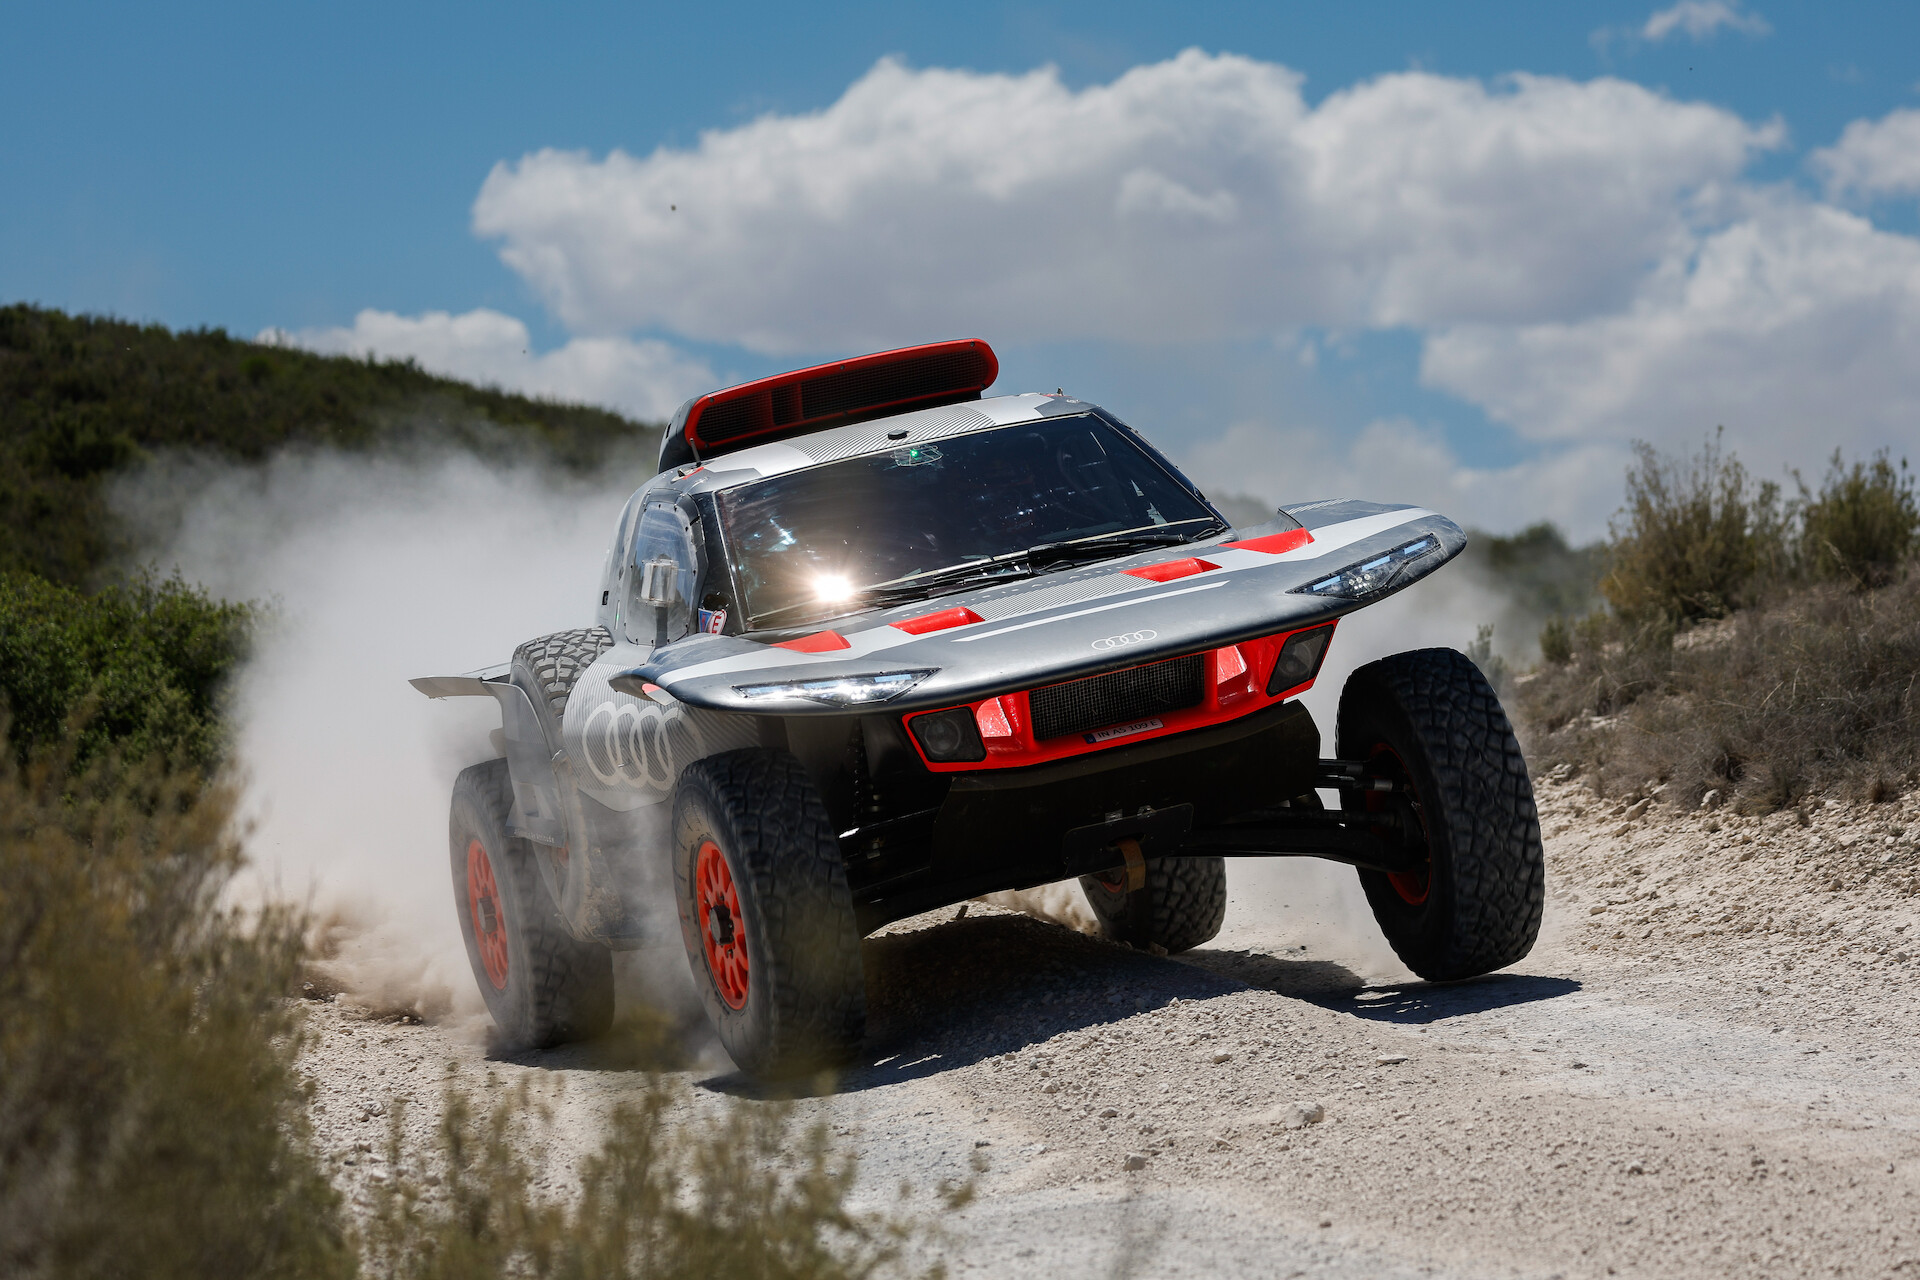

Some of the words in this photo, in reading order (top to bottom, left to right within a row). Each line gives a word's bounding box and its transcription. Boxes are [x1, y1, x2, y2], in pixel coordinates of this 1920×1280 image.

[712, 615, 721, 634] E
[1113, 727, 1126, 735] AS
[1128, 722, 1148, 732] 109
